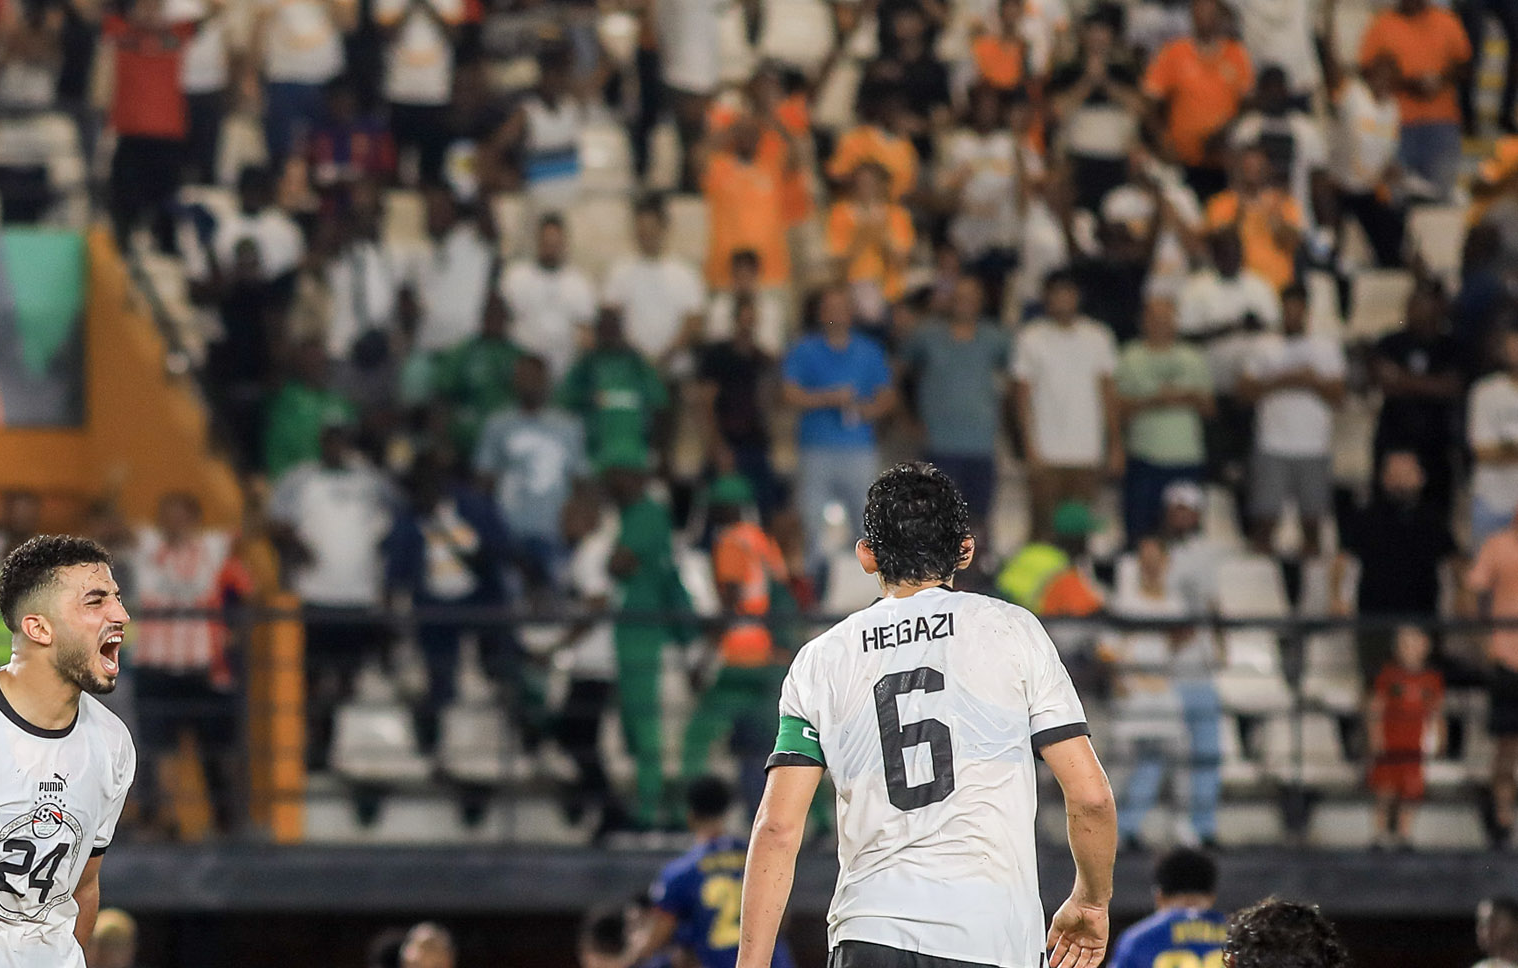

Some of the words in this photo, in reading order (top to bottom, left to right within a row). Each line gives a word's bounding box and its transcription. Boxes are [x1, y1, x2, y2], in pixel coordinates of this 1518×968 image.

[862, 613, 954, 652] HEGAZI
[874, 667, 955, 812] 6
[39, 782, 63, 792] PUMA
